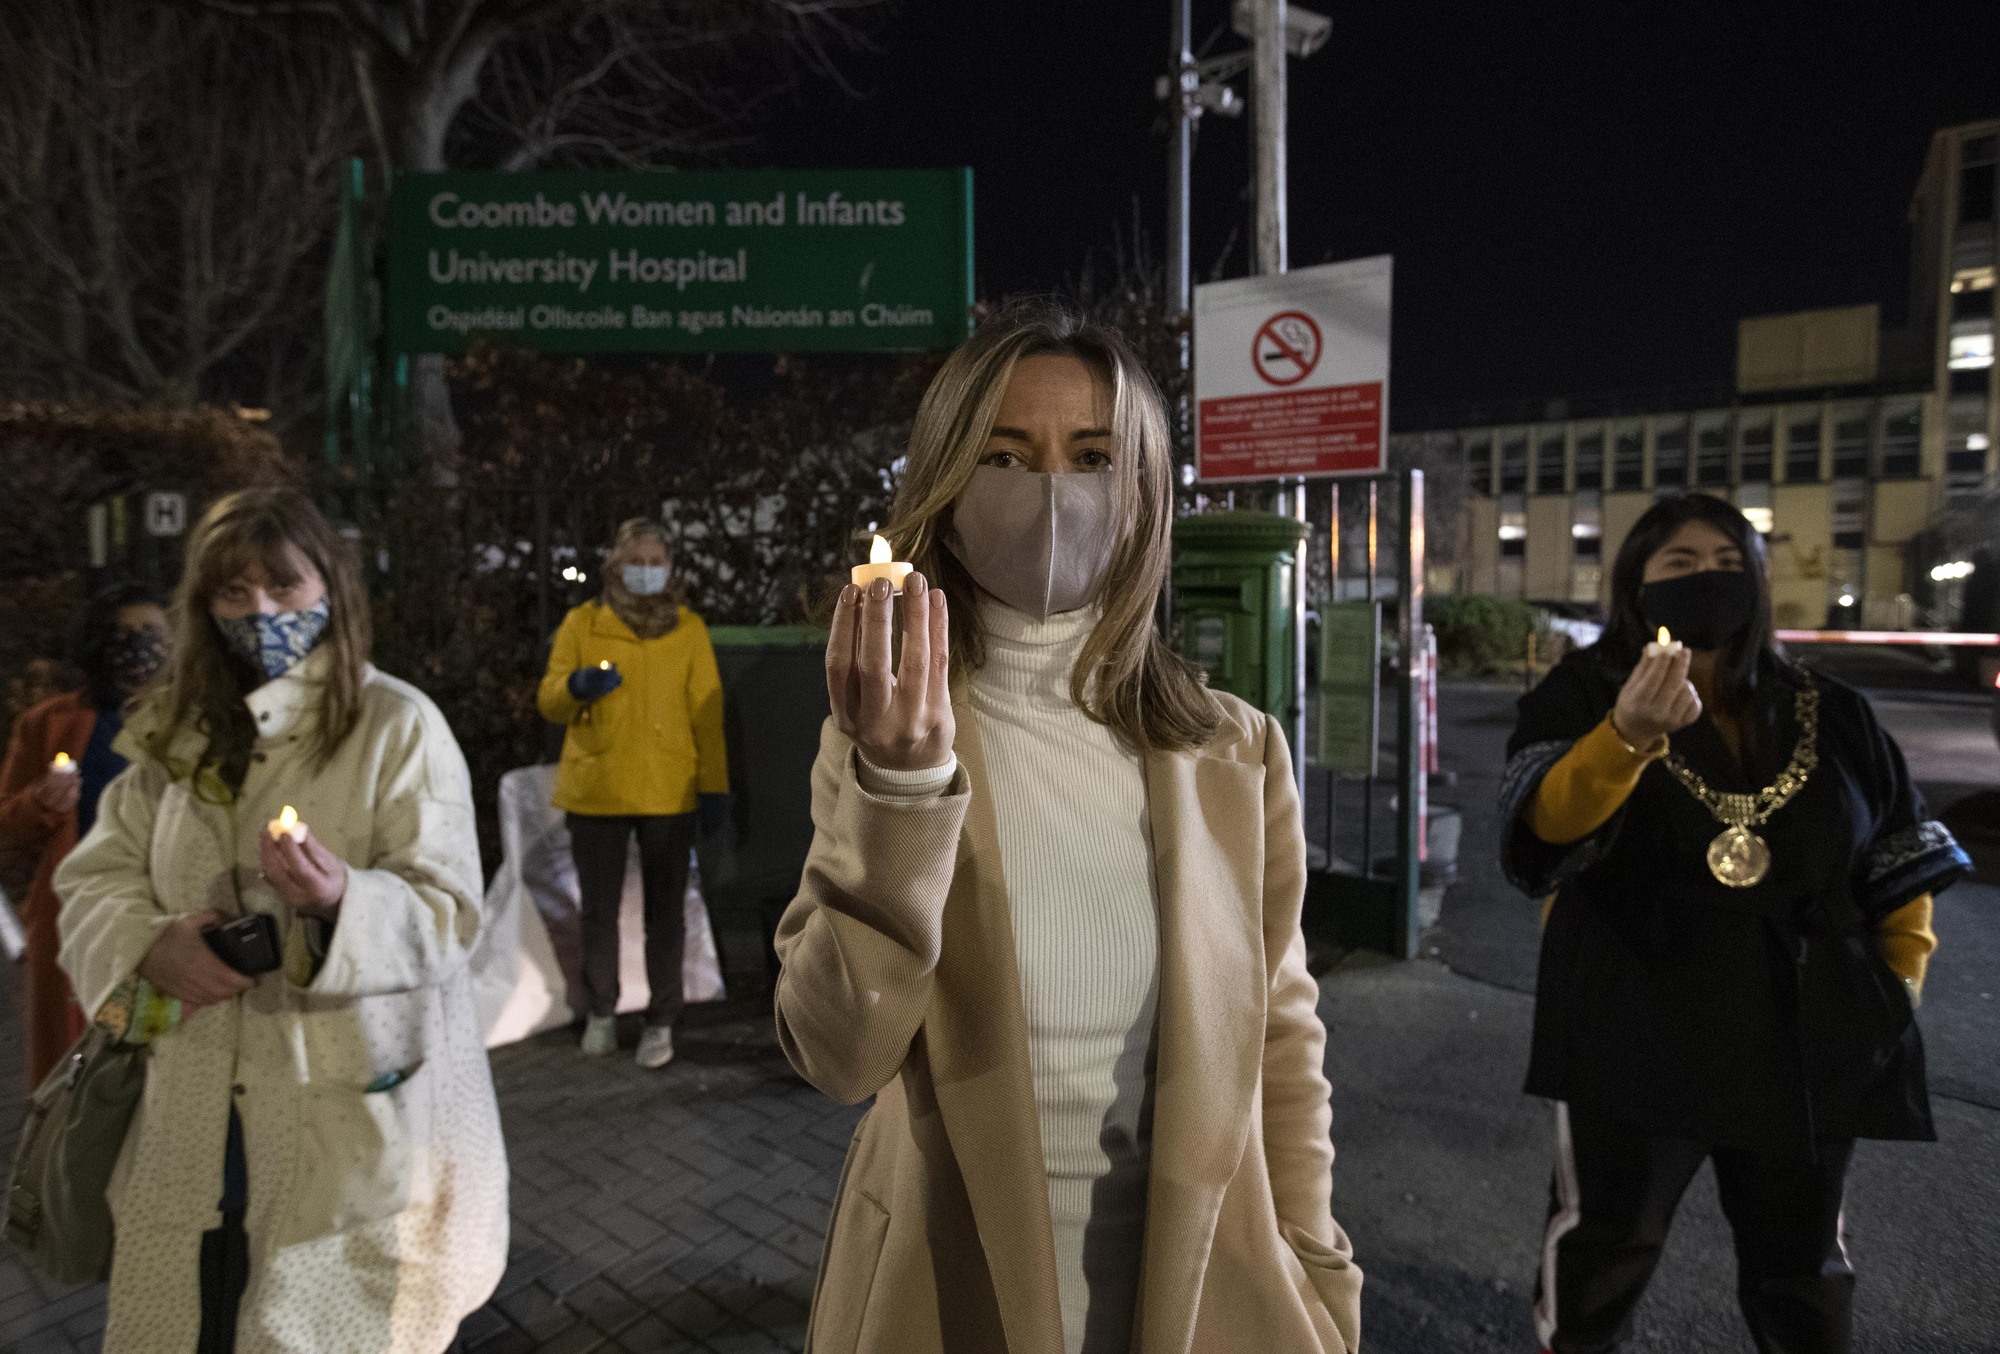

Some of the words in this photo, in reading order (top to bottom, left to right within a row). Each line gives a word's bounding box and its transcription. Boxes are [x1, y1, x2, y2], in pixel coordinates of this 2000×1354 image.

[429, 192, 577, 228] Coombe
[580, 192, 716, 227] Women
[725, 192, 786, 226] and
[796, 191, 906, 226] Infants
[428, 249, 599, 292] University
[609, 248, 747, 292] Hospital
[529, 303, 626, 330] Ollscoile
[631, 304, 673, 329] Ban
[677, 310, 727, 335] agus
[827, 309, 856, 328] an
